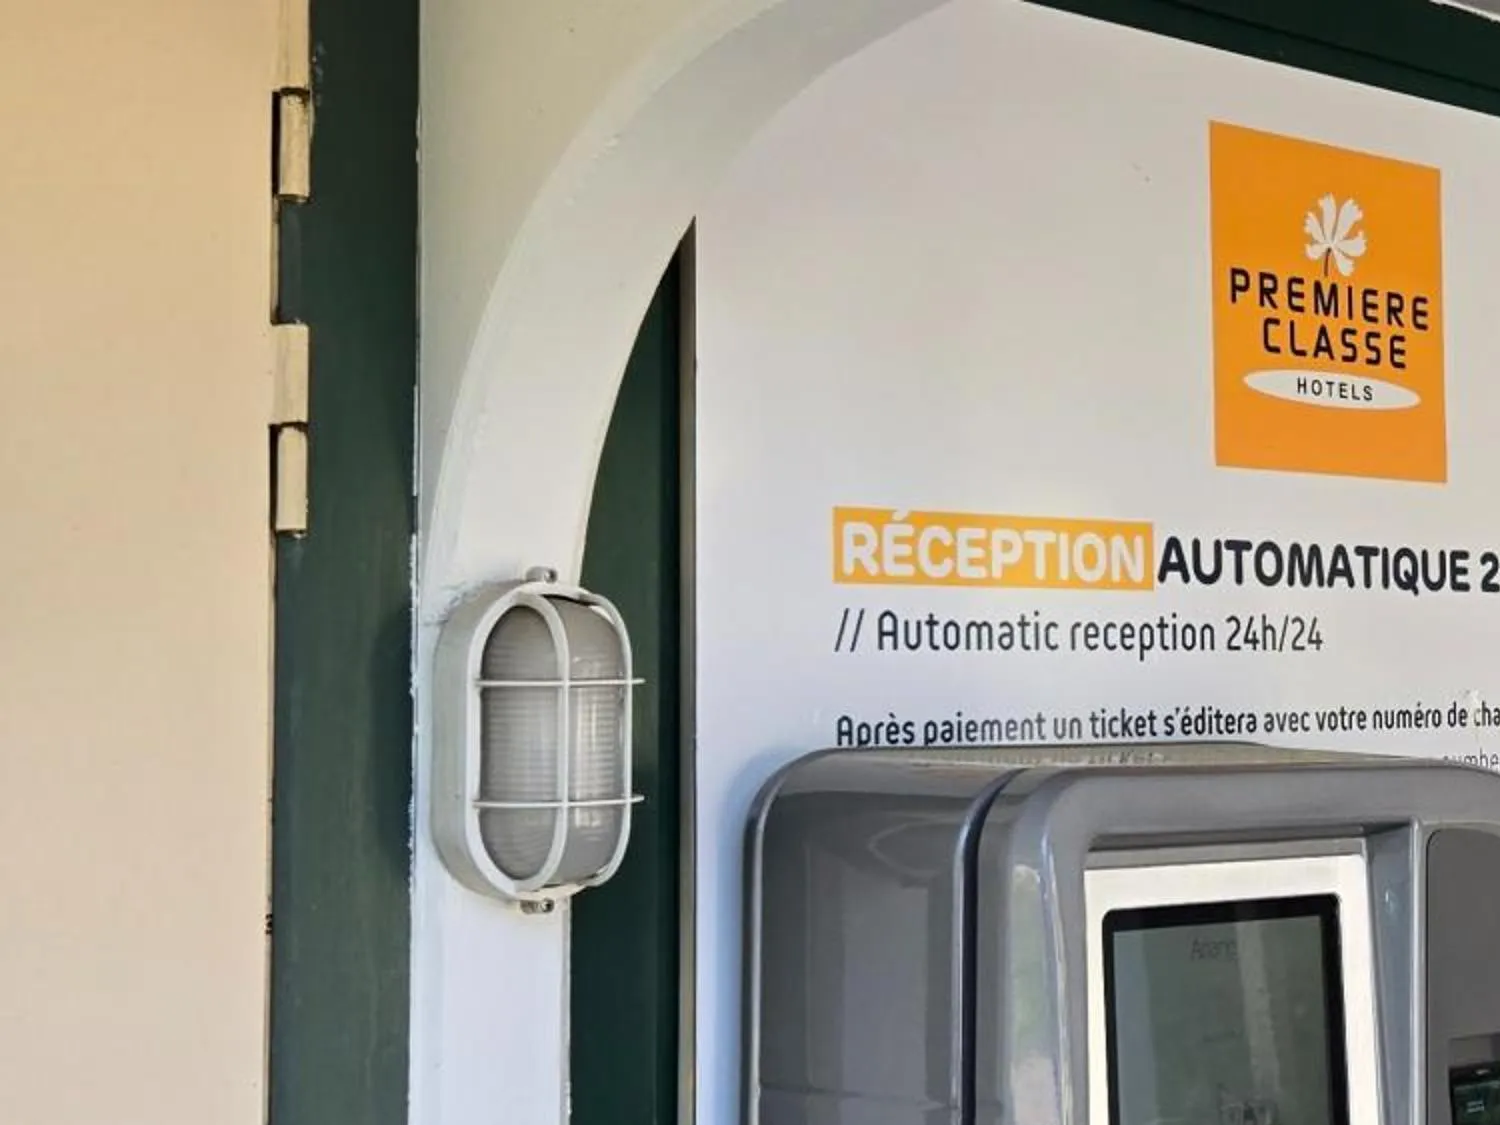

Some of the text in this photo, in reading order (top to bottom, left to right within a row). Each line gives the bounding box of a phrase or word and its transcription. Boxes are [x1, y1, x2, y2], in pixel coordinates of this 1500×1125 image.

[1230, 268, 1429, 331] PREMIERE
[1263, 317, 1406, 369] CLASSE
[1297, 376, 1374, 402] HOTELS
[842, 509, 1145, 583] RÉCEPTION
[1157, 535, 1471, 596] AUTOMATIQUE
[877, 610, 1059, 652] Automatic
[1070, 612, 1215, 661] reception
[1226, 615, 1323, 652] 24h/24
[837, 712, 915, 747] Après
[924, 711, 1046, 746] paiement
[1054, 716, 1082, 740] un
[1088, 708, 1157, 739] ticket
[1163, 706, 1257, 737] s'éditera
[1264, 713, 1310, 733] avec
[1316, 706, 1367, 732] votre
[1372, 702, 1442, 730] numéro
[1447, 701, 1468, 728] de
